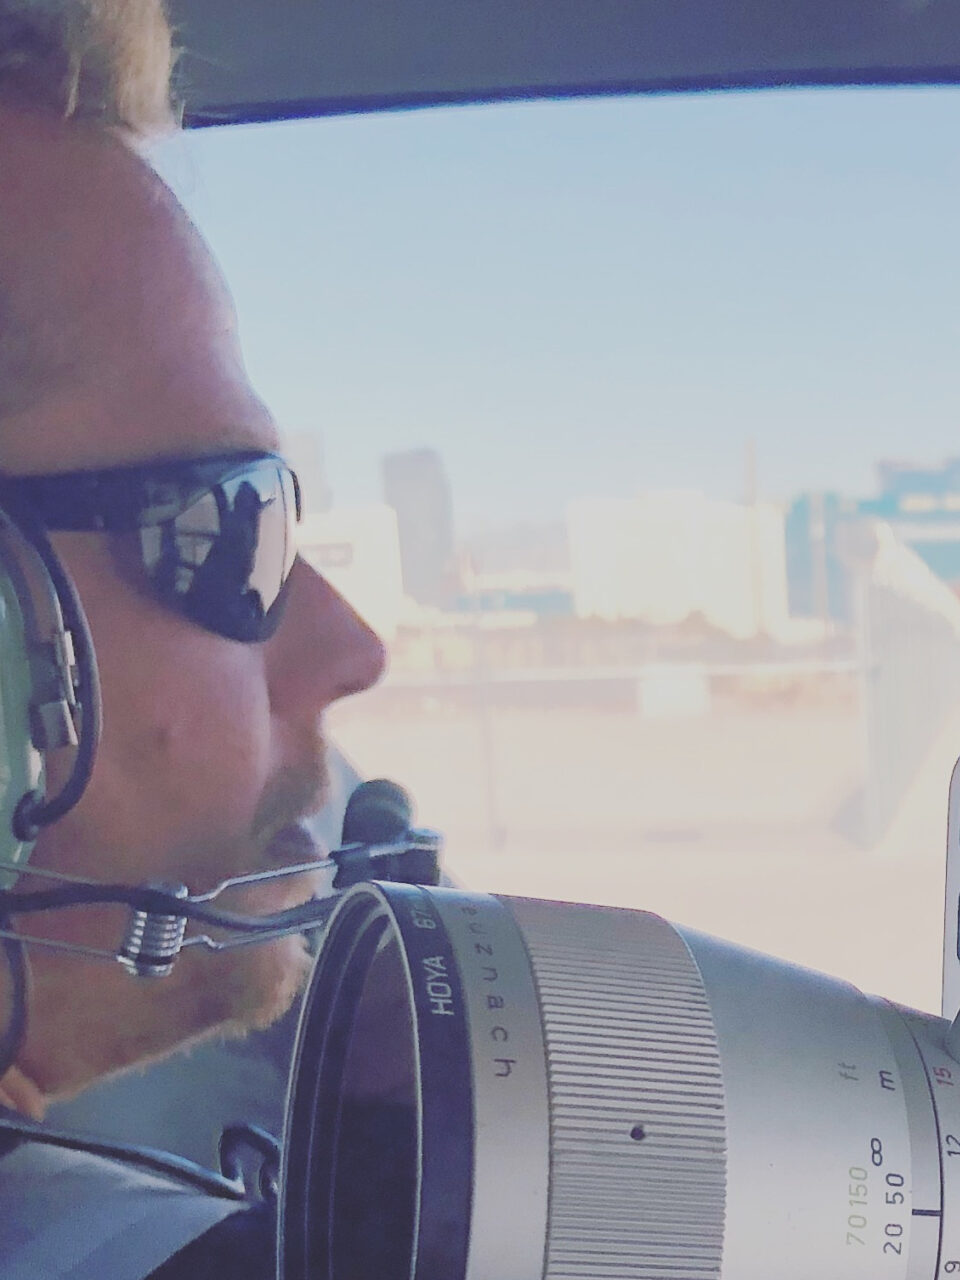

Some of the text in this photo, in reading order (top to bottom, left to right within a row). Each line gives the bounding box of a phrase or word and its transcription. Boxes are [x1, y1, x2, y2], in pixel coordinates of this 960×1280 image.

[422, 955, 455, 1016] HOYA
[878, 1070, 896, 1091] m
[934, 1066, 955, 1087] 15
[848, 1166, 868, 1207] 150
[885, 1173, 905, 1205] 50
[847, 1214, 867, 1247] 70
[883, 1222, 903, 1255] 20
